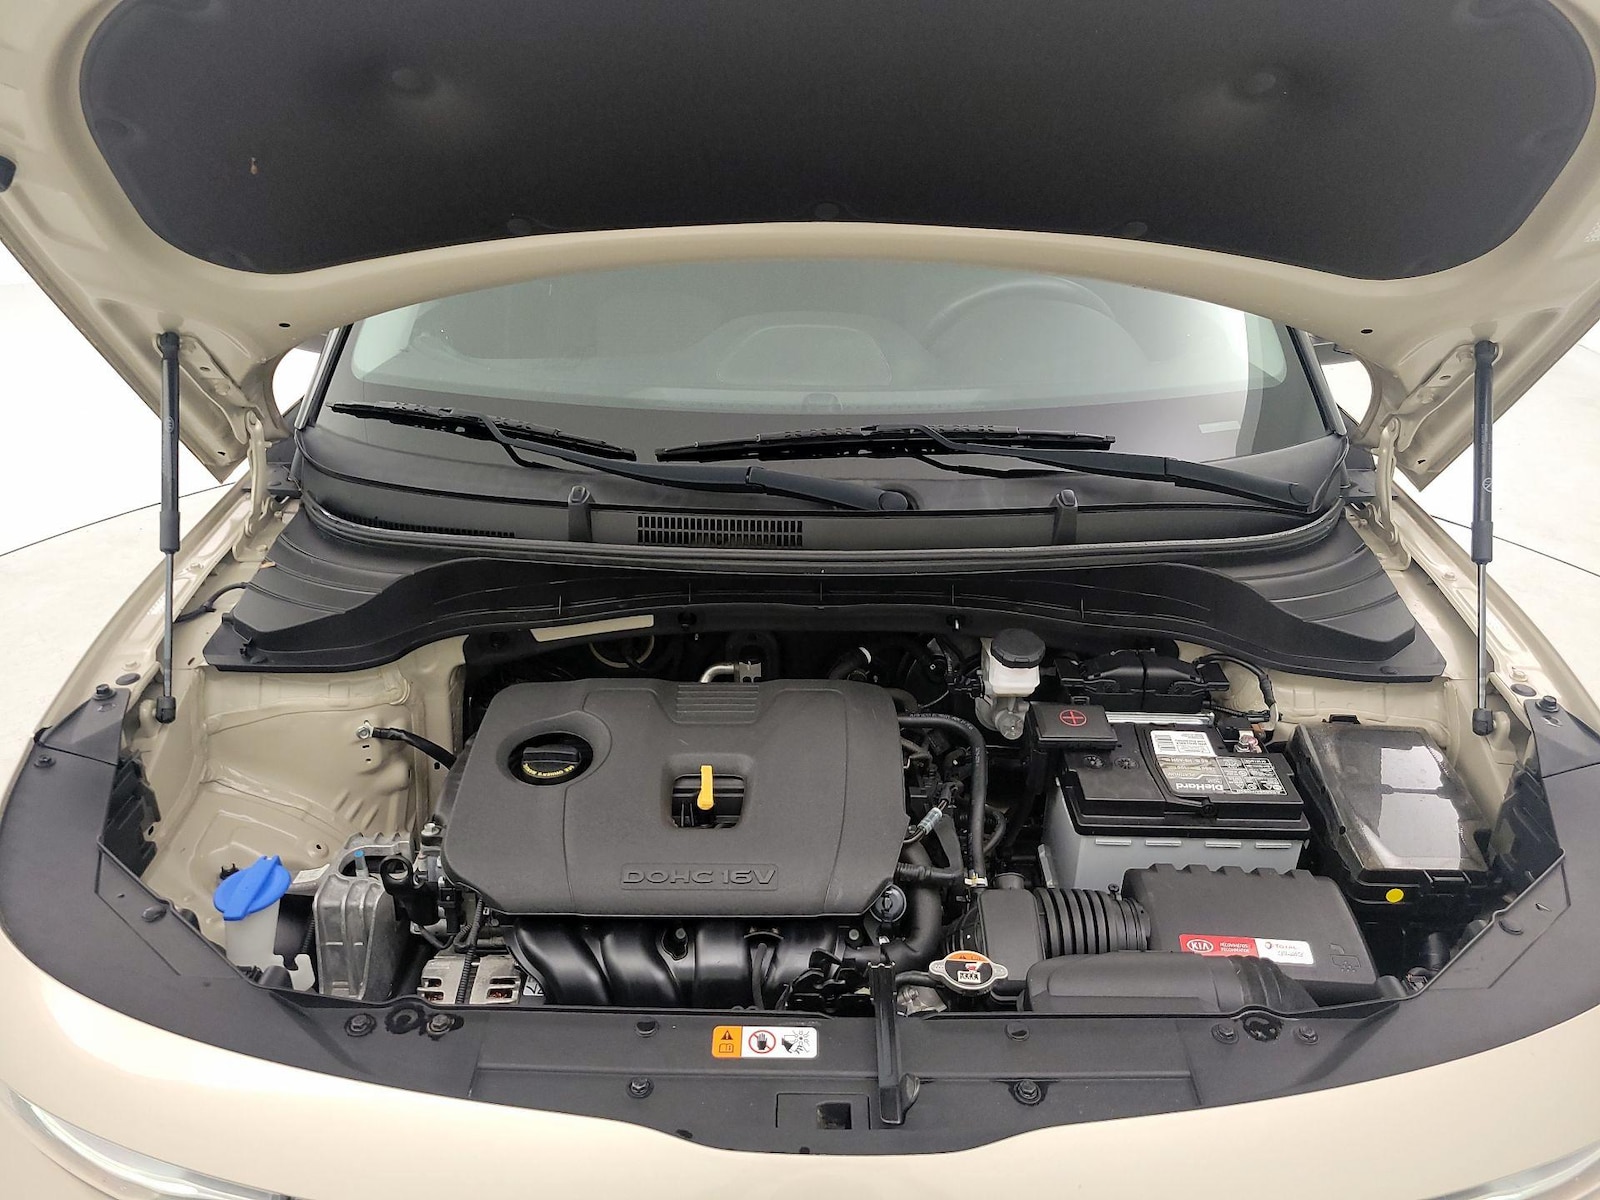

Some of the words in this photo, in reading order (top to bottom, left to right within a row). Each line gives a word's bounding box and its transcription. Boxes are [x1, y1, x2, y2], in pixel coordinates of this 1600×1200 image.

[1175, 782, 1224, 791] DieHard
[622, 869, 714, 884] DOHC
[721, 869, 776, 885] 16V
[1190, 941, 1211, 951] KIA
